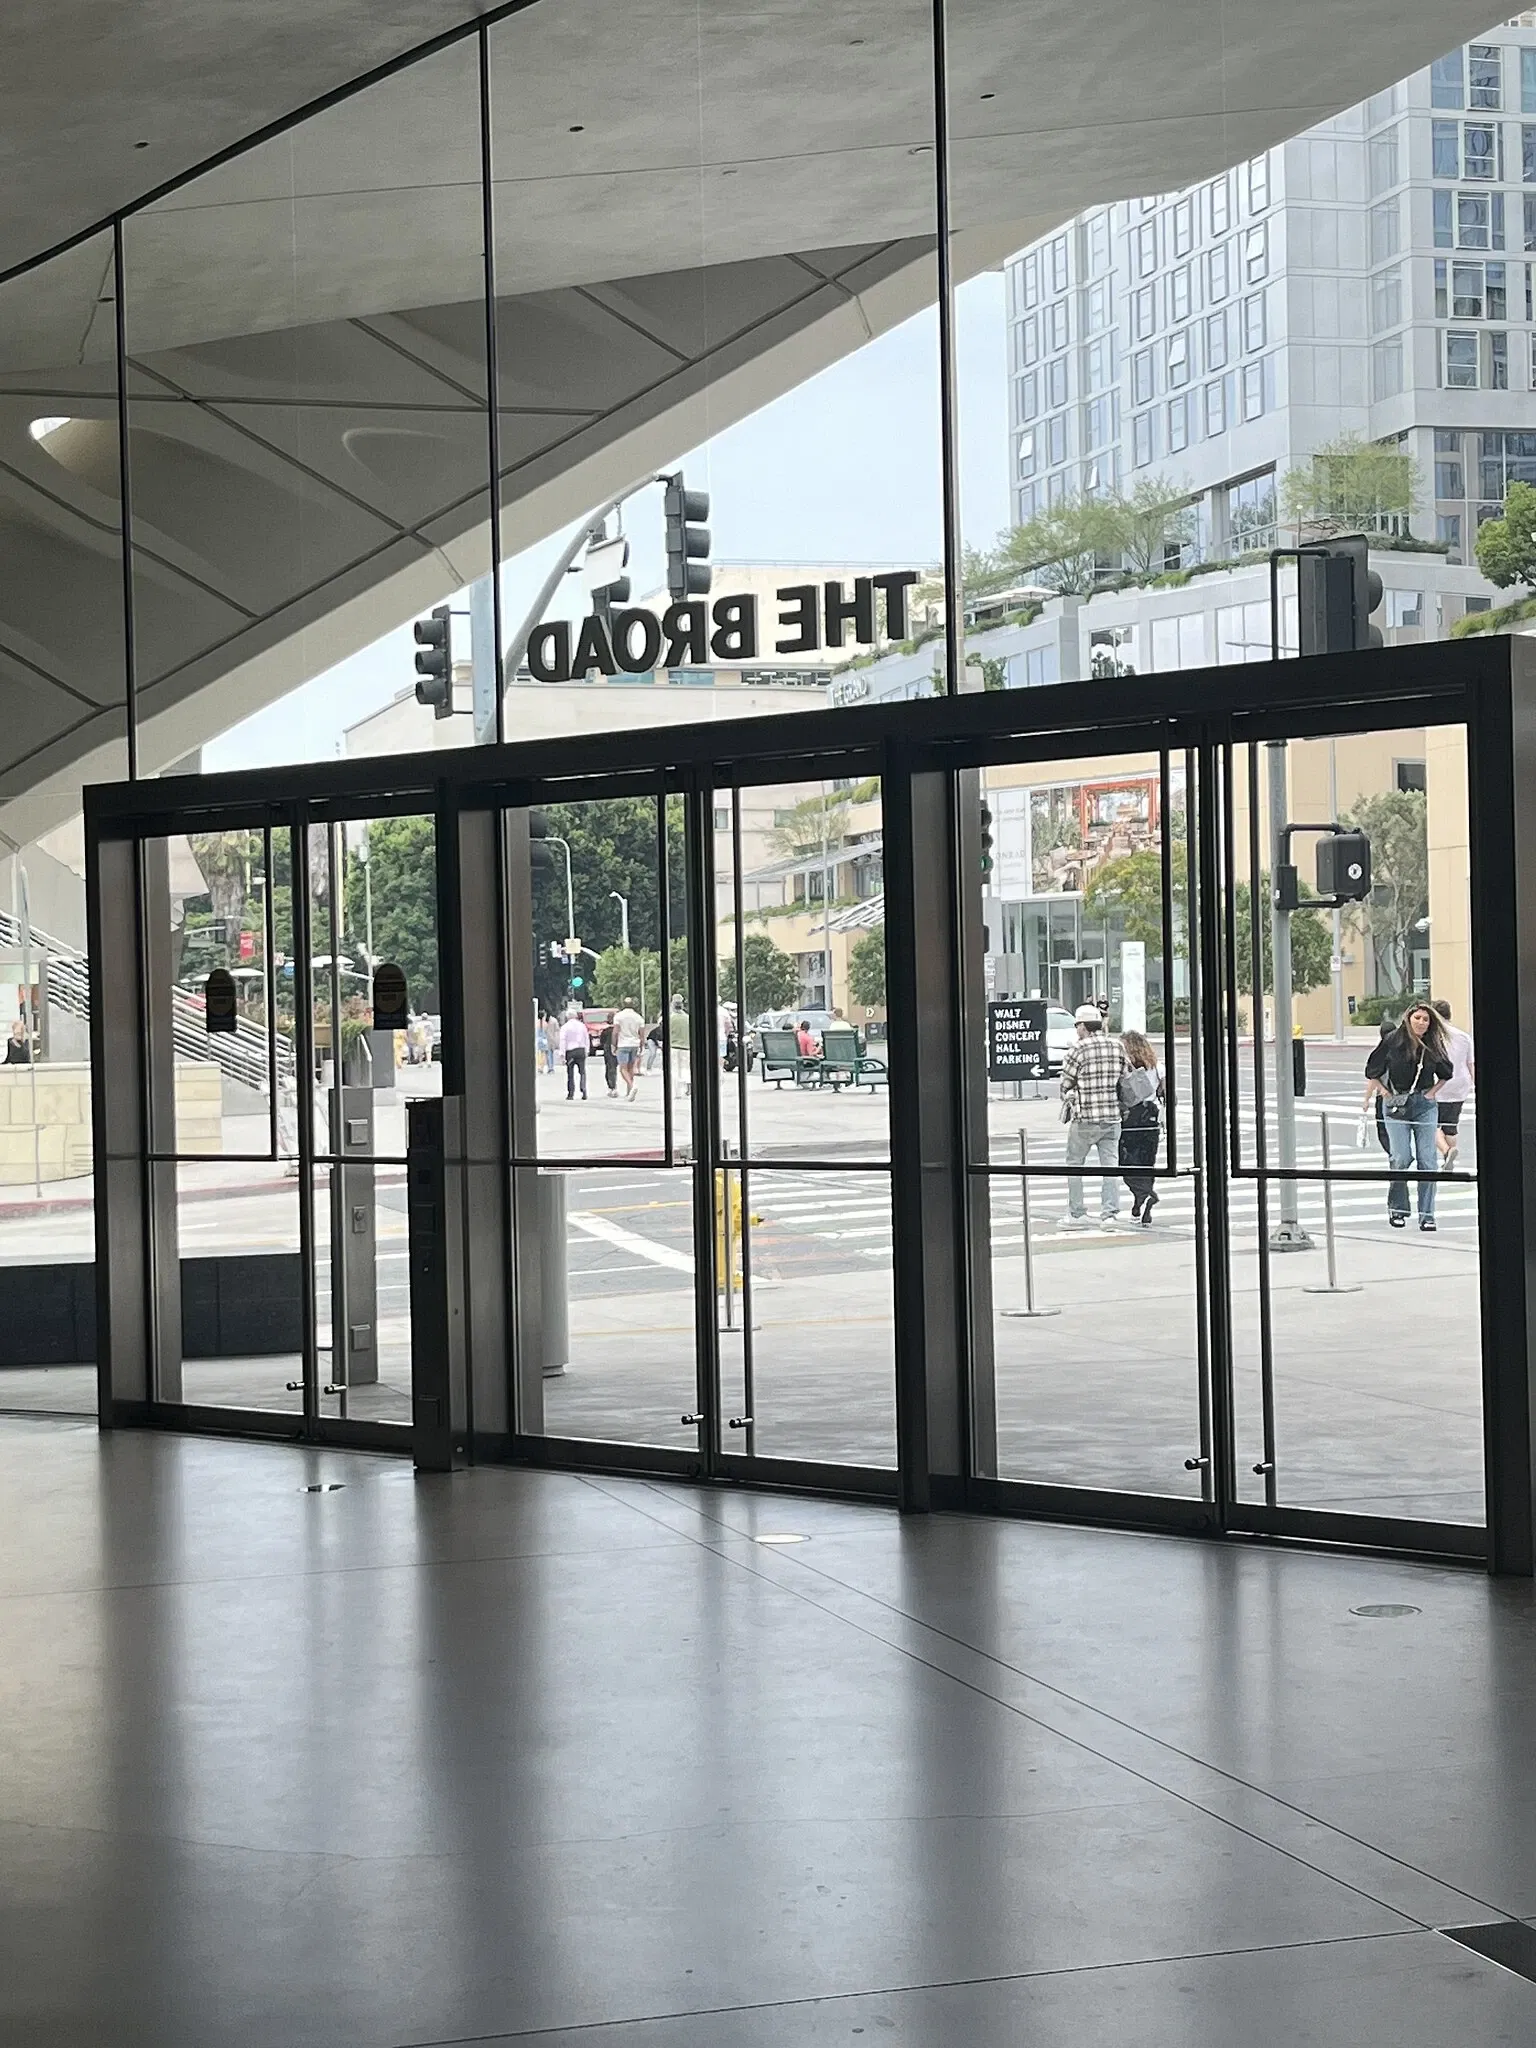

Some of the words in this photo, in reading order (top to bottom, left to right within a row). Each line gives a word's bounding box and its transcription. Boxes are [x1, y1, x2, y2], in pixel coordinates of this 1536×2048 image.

[994, 1008, 1022, 1019] WALT
[995, 1020, 1031, 1031] DISNEY
[995, 1031, 1041, 1042] CONCERT
[995, 1043, 1021, 1053] HALL
[996, 1053, 1040, 1064] PARKING
